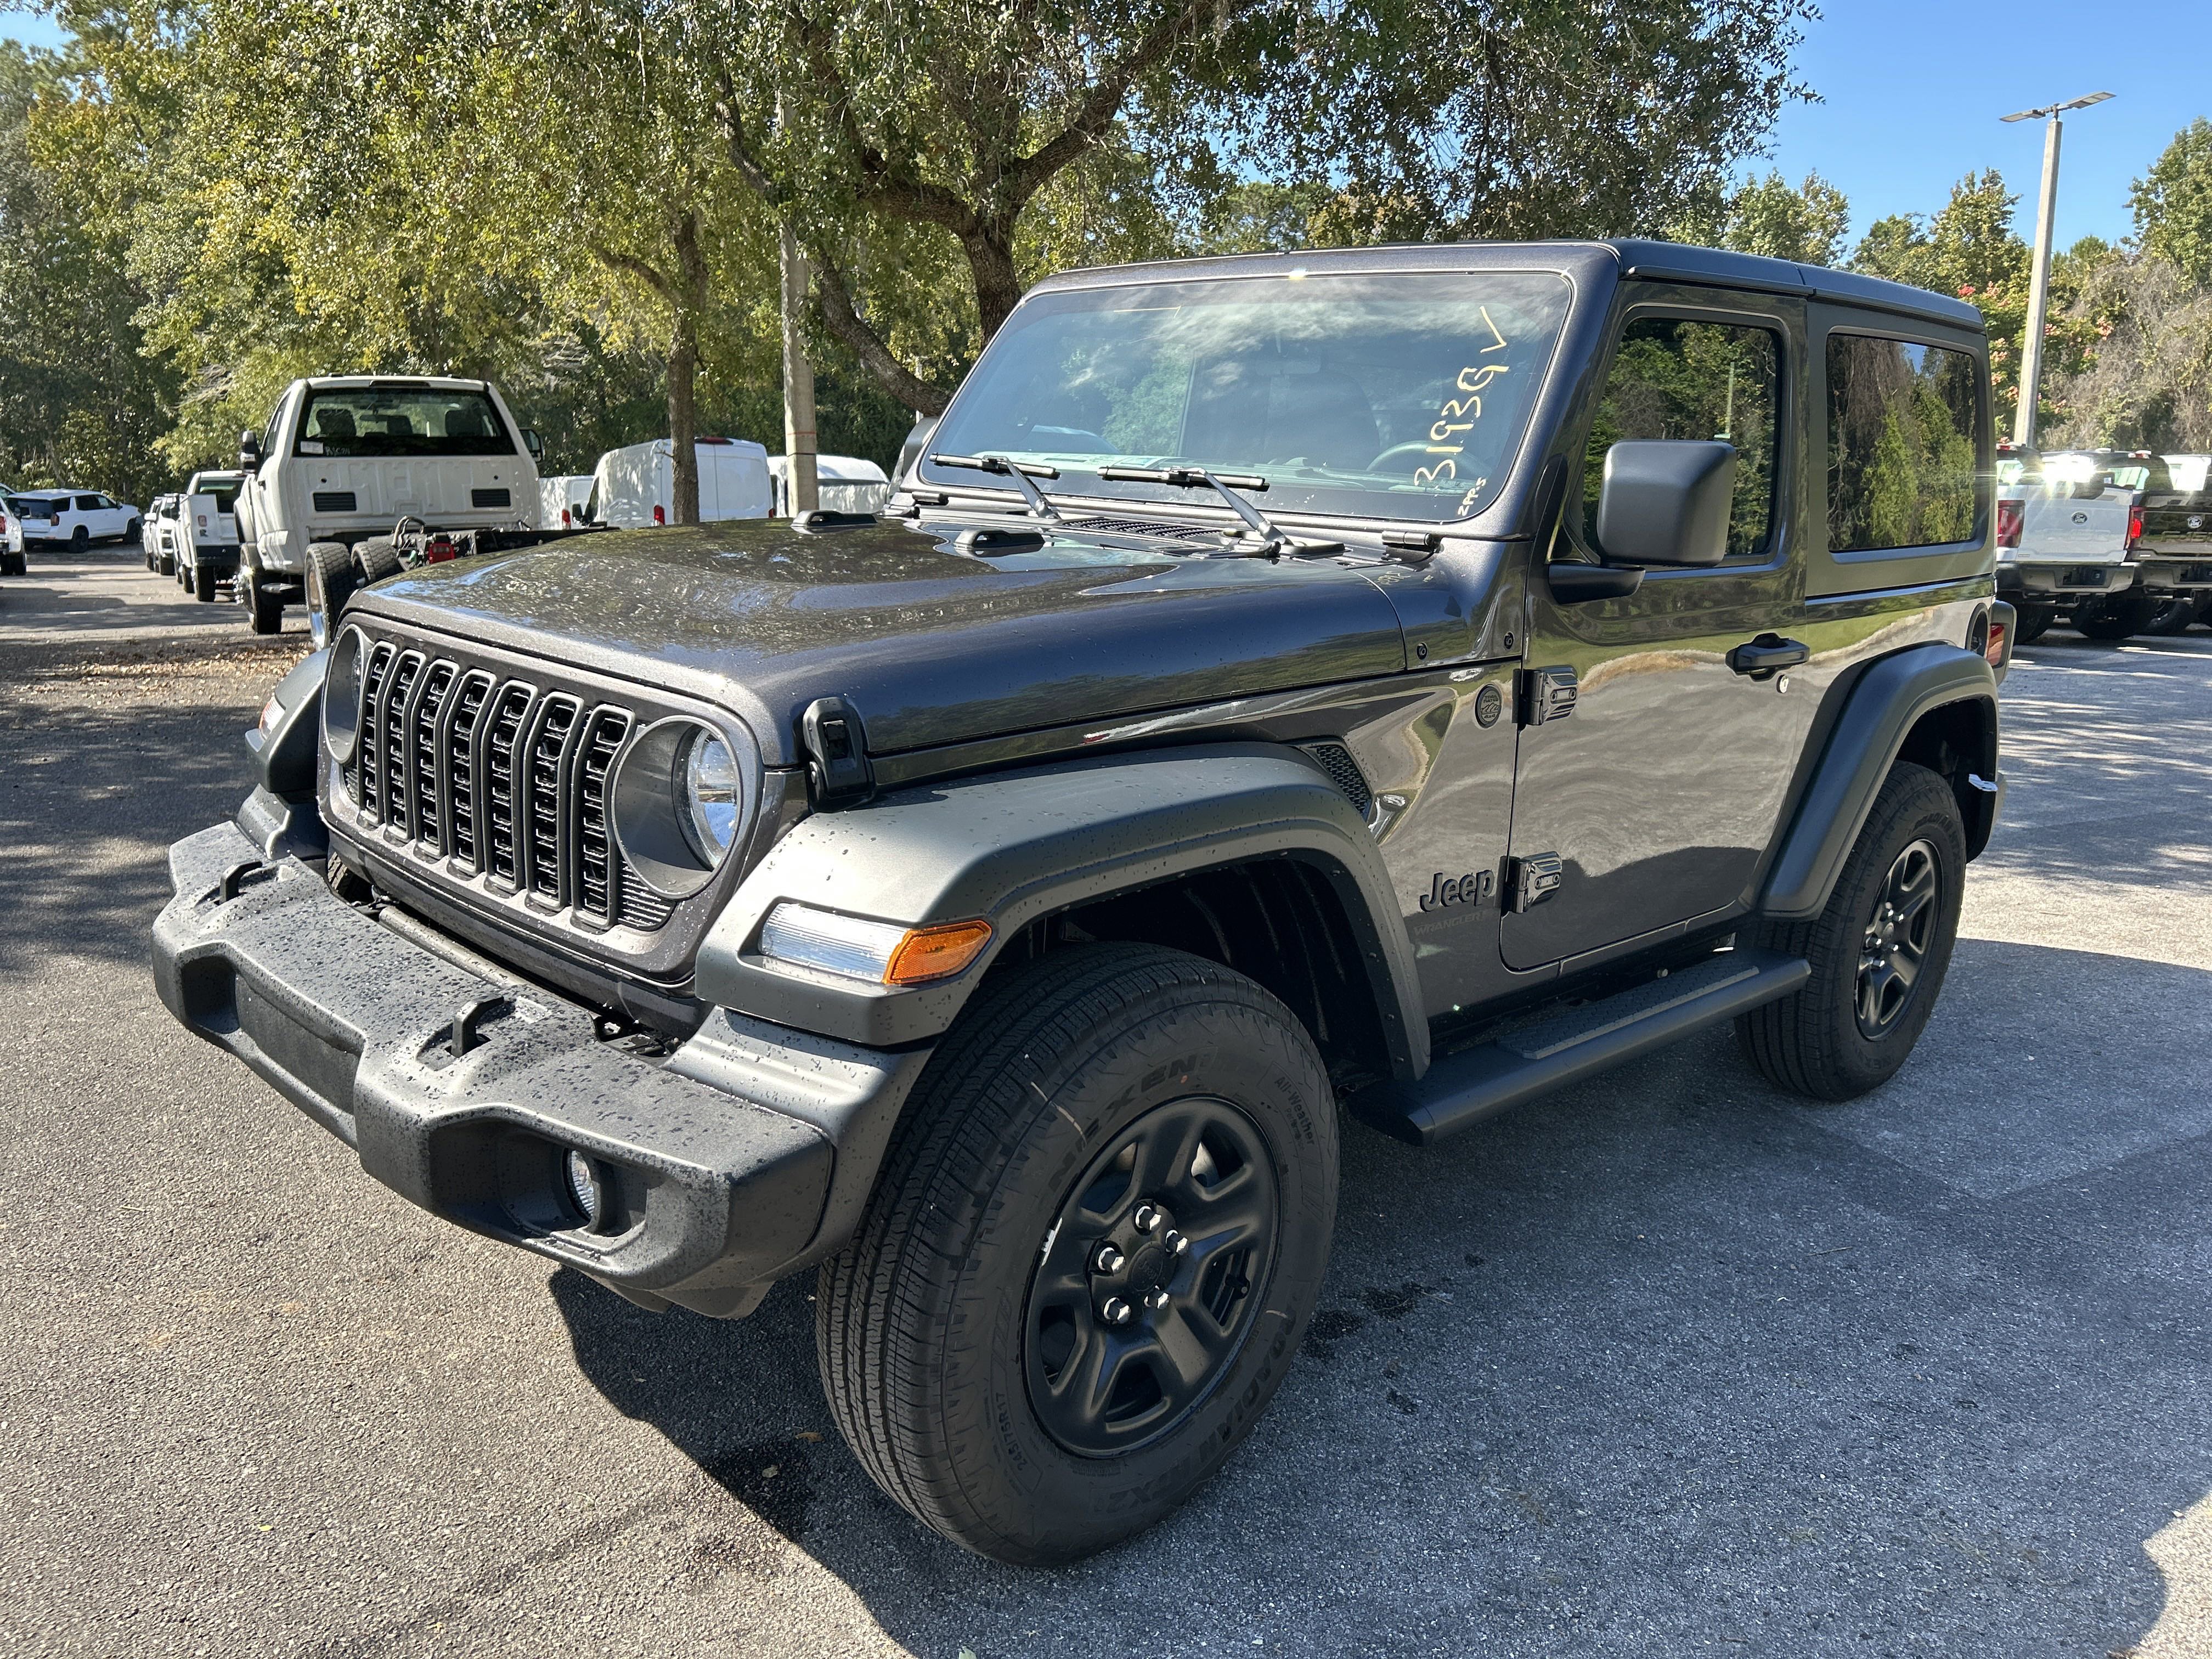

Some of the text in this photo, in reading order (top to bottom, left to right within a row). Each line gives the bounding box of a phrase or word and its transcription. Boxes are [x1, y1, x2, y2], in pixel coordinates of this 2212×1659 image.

[1413, 911, 1482, 936] WRANGLER
[1419, 870, 1496, 912] Jeep
[1048, 1053, 1198, 1193] NEXEN
[1273, 1076, 1316, 1147] All-Weather
[995, 1392, 1029, 1472] 245/75R17
